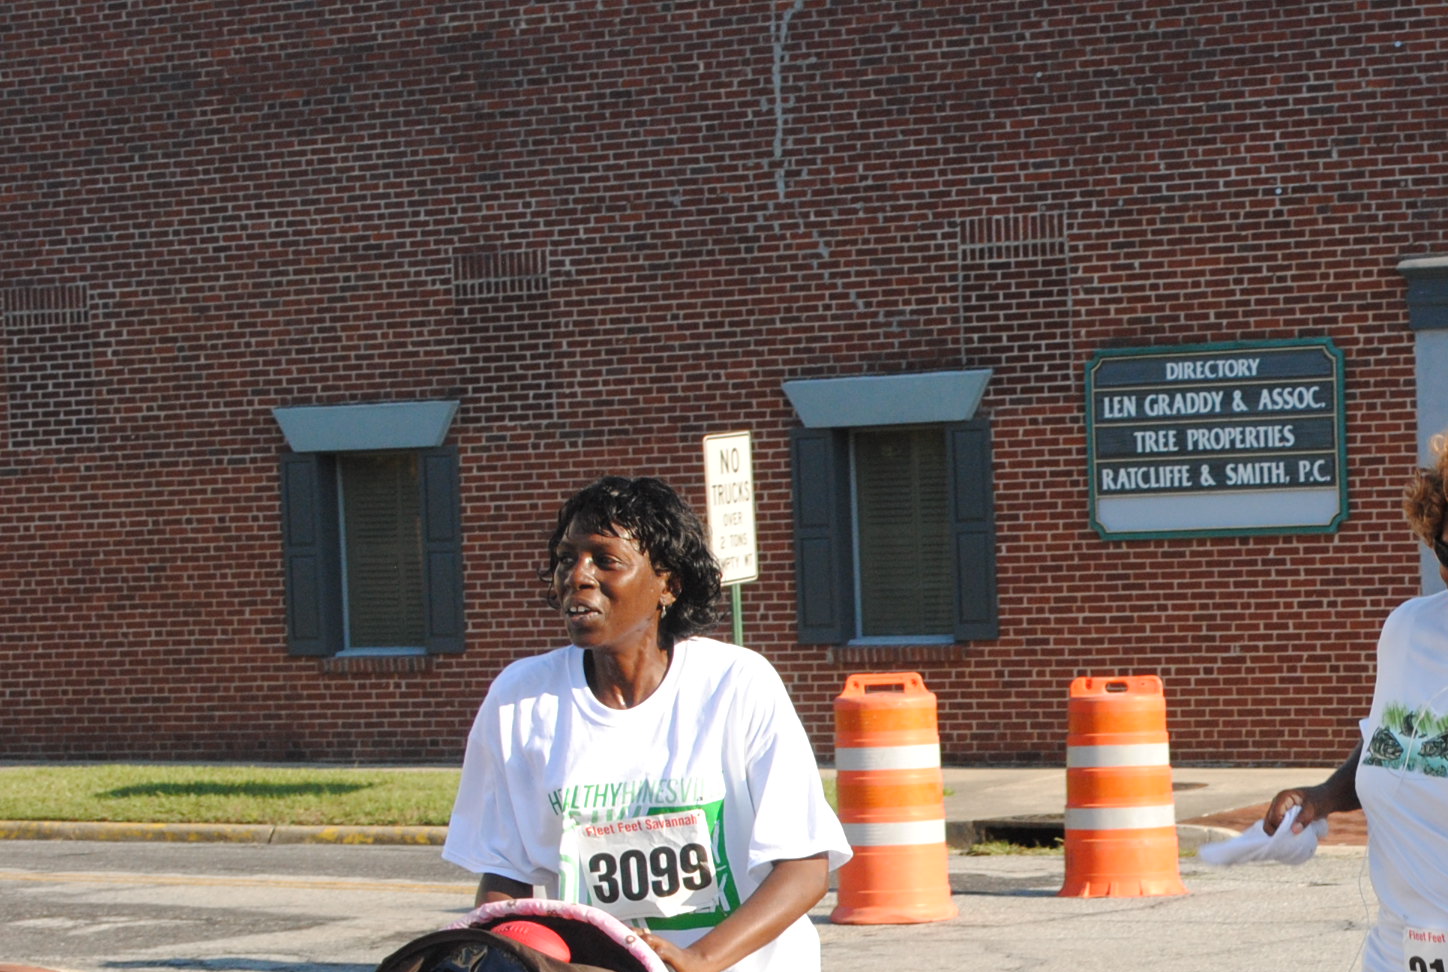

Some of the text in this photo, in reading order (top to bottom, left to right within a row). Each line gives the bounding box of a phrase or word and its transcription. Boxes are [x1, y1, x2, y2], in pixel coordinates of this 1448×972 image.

[1165, 358, 1260, 381] DIRECTORY
[1103, 386, 1326, 419] LEN GRADDY & ASSOC.
[1133, 425, 1296, 453] TREE PROPERTIES
[719, 447, 741, 475] NO
[1102, 459, 1331, 491] RATCLIFFE & SMITH, P.C.
[711, 480, 750, 506] TRUCKS
[723, 511, 743, 527] OVER
[719, 532, 748, 550] 2 TONS
[585, 824, 616, 838] Fleet
[618, 821, 643, 834] Feet
[645, 813, 698, 831] Savannah
[588, 842, 713, 904] 3099
[1408, 929, 1427, 941] Fleet
[1427, 931, 1446, 943] Feet
